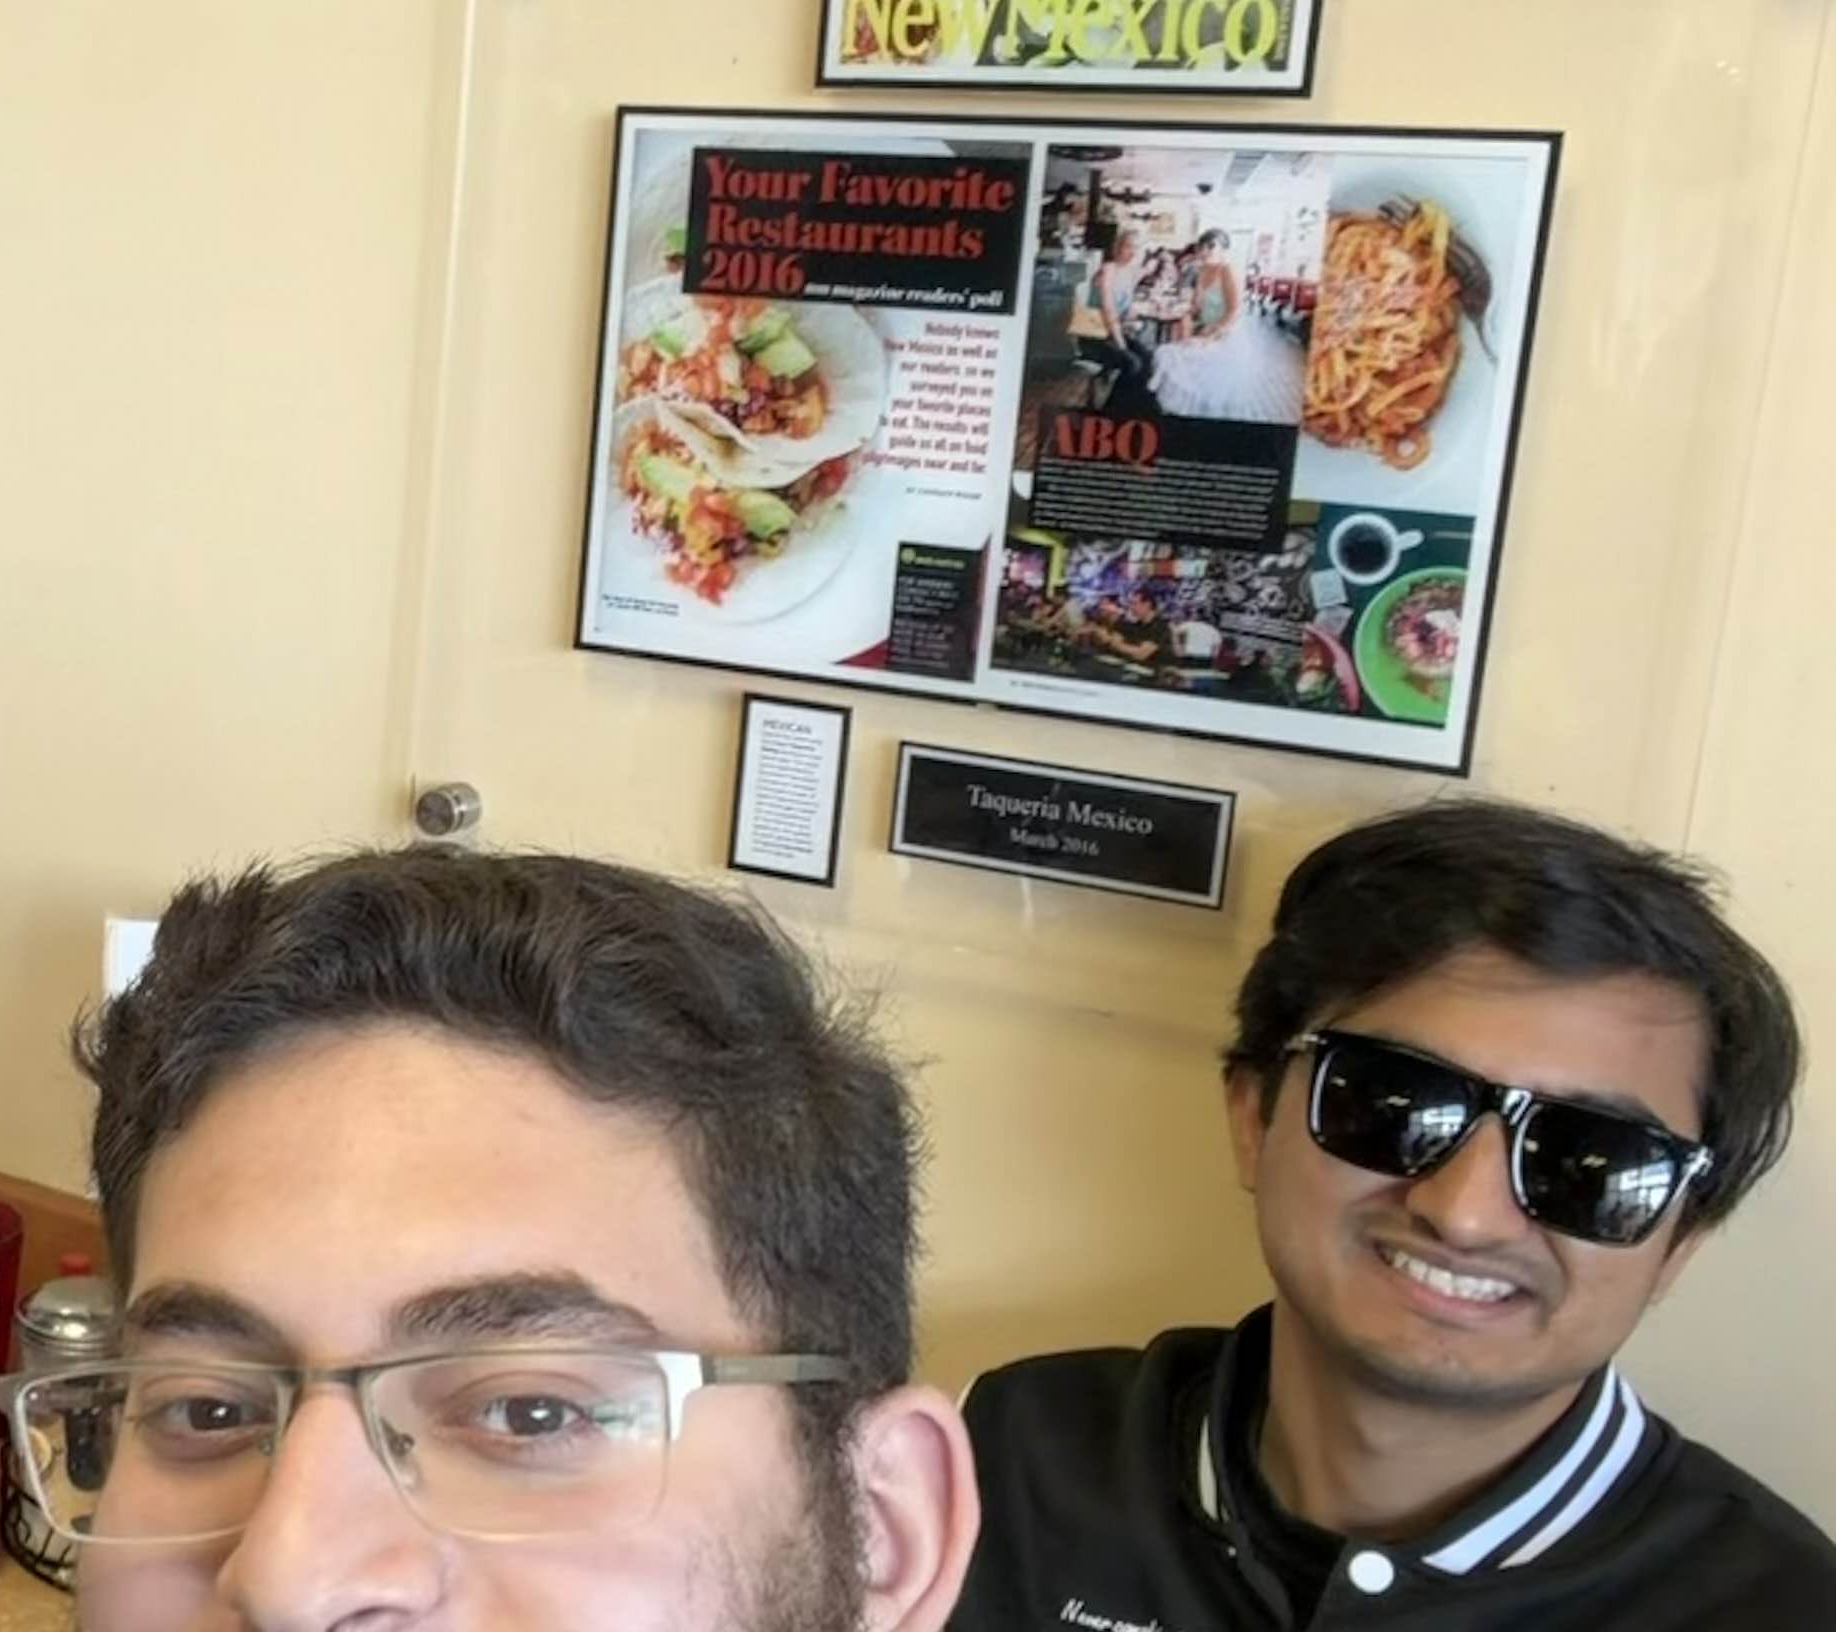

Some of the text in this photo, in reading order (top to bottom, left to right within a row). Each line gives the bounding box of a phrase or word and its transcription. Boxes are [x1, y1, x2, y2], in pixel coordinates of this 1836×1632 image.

[706, 155, 1014, 212] Your Favorite
[706, 203, 985, 259] Restaurants
[700, 248, 806, 295] 2016
[1053, 414, 1160, 479] ABQ
[967, 784, 1154, 836] Taqueria Mexico
[1010, 827, 1100, 857] March 2016
